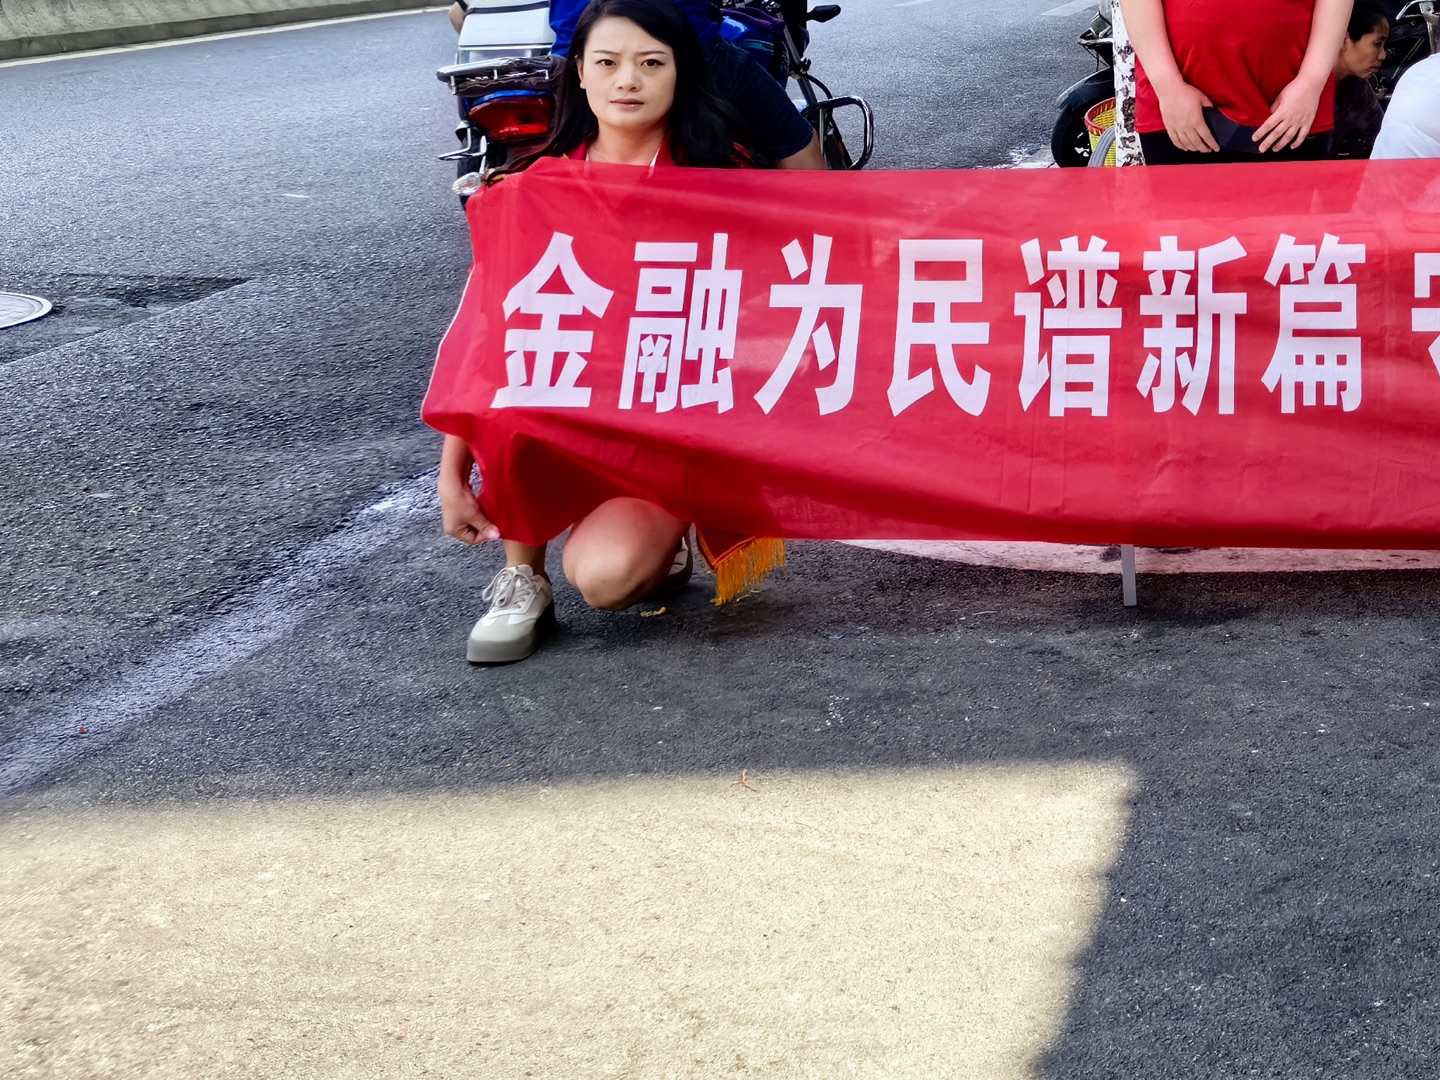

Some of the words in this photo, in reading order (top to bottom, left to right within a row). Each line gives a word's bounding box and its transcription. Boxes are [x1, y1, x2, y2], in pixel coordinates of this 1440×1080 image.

[490, 231, 1367, 418] 金融为民谱新篇
